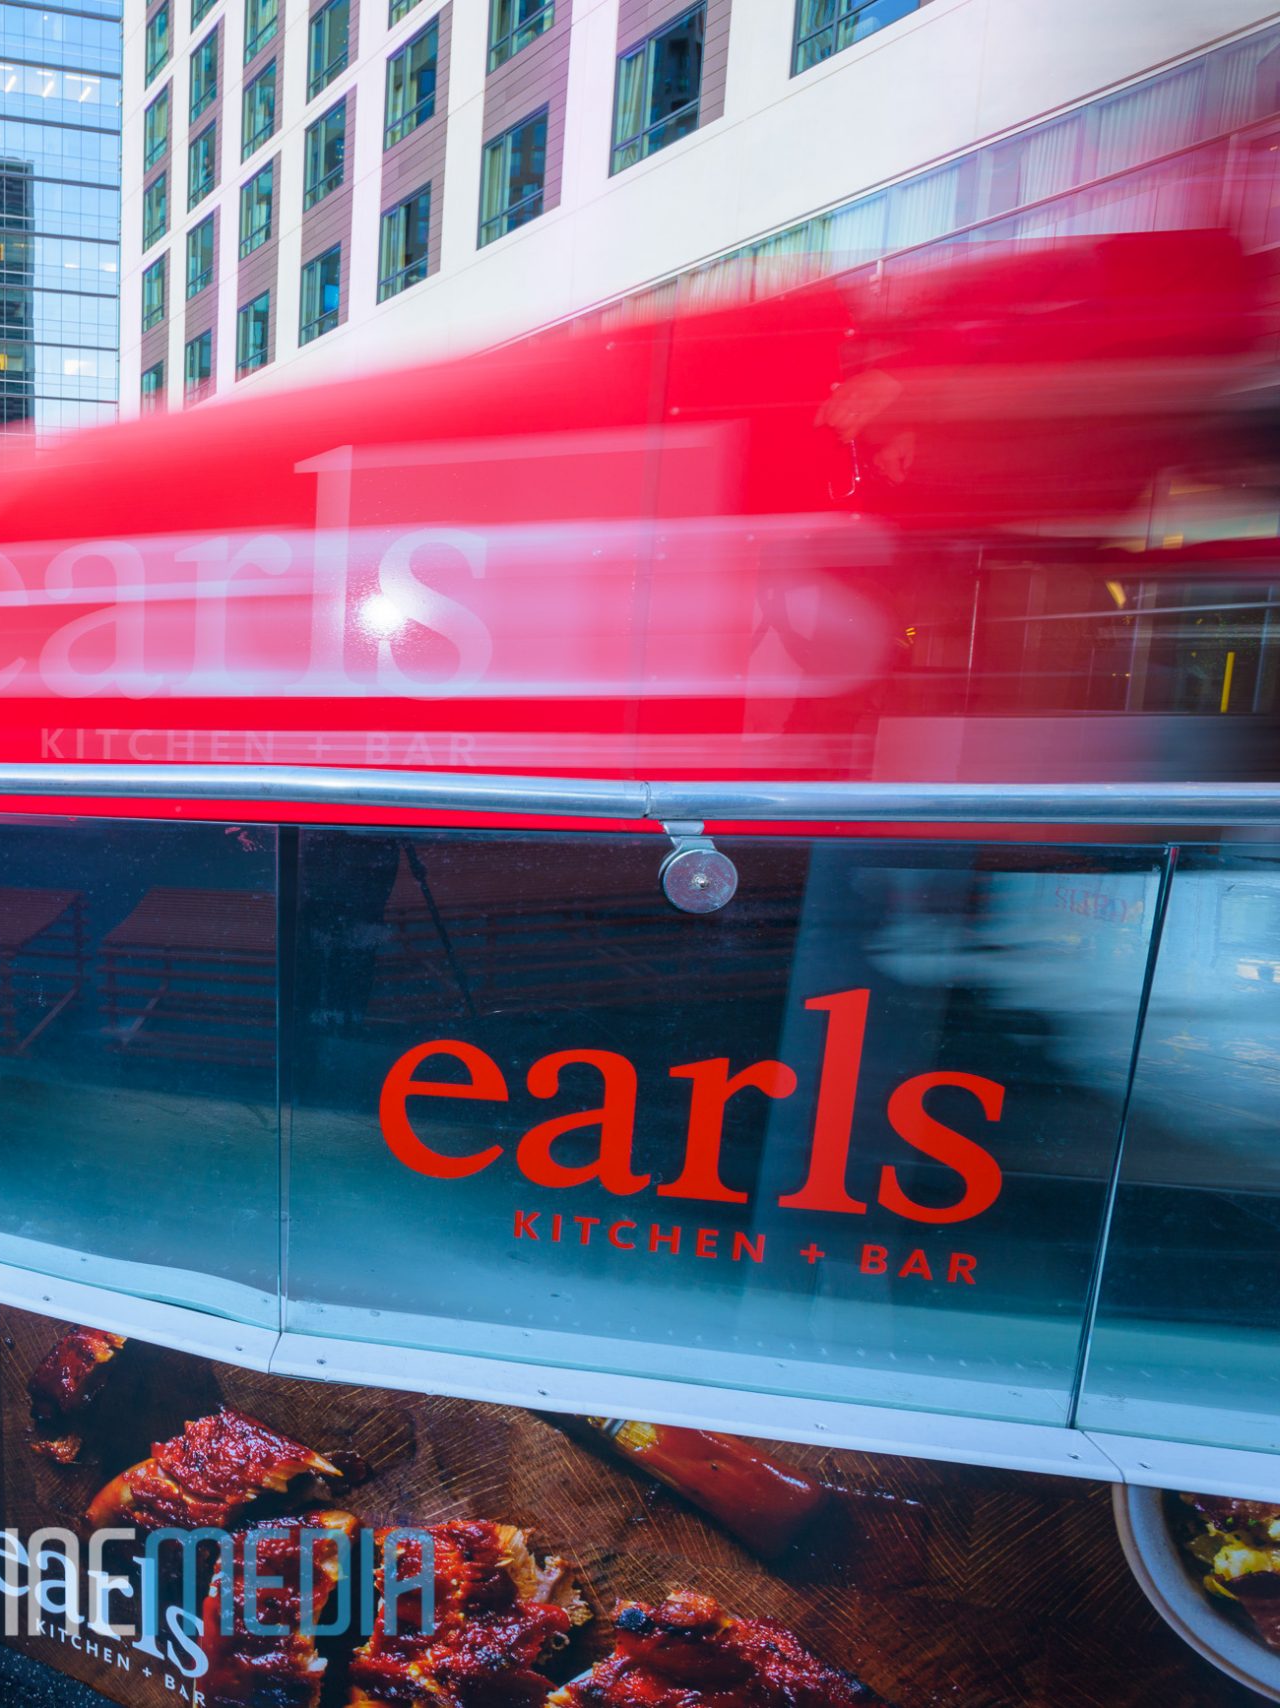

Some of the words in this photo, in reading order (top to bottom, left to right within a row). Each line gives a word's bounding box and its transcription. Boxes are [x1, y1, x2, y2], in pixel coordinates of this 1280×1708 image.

[39, 727, 277, 766] KITCHEN
[365, 731, 479, 768] BAR
[379, 988, 1005, 1224] earls
[513, 1210, 766, 1263] KITCHEN
[859, 1244, 980, 1286] BAR
[35, 1617, 131, 1672] KITCHEN
[164, 1673, 207, 1707] BAR
